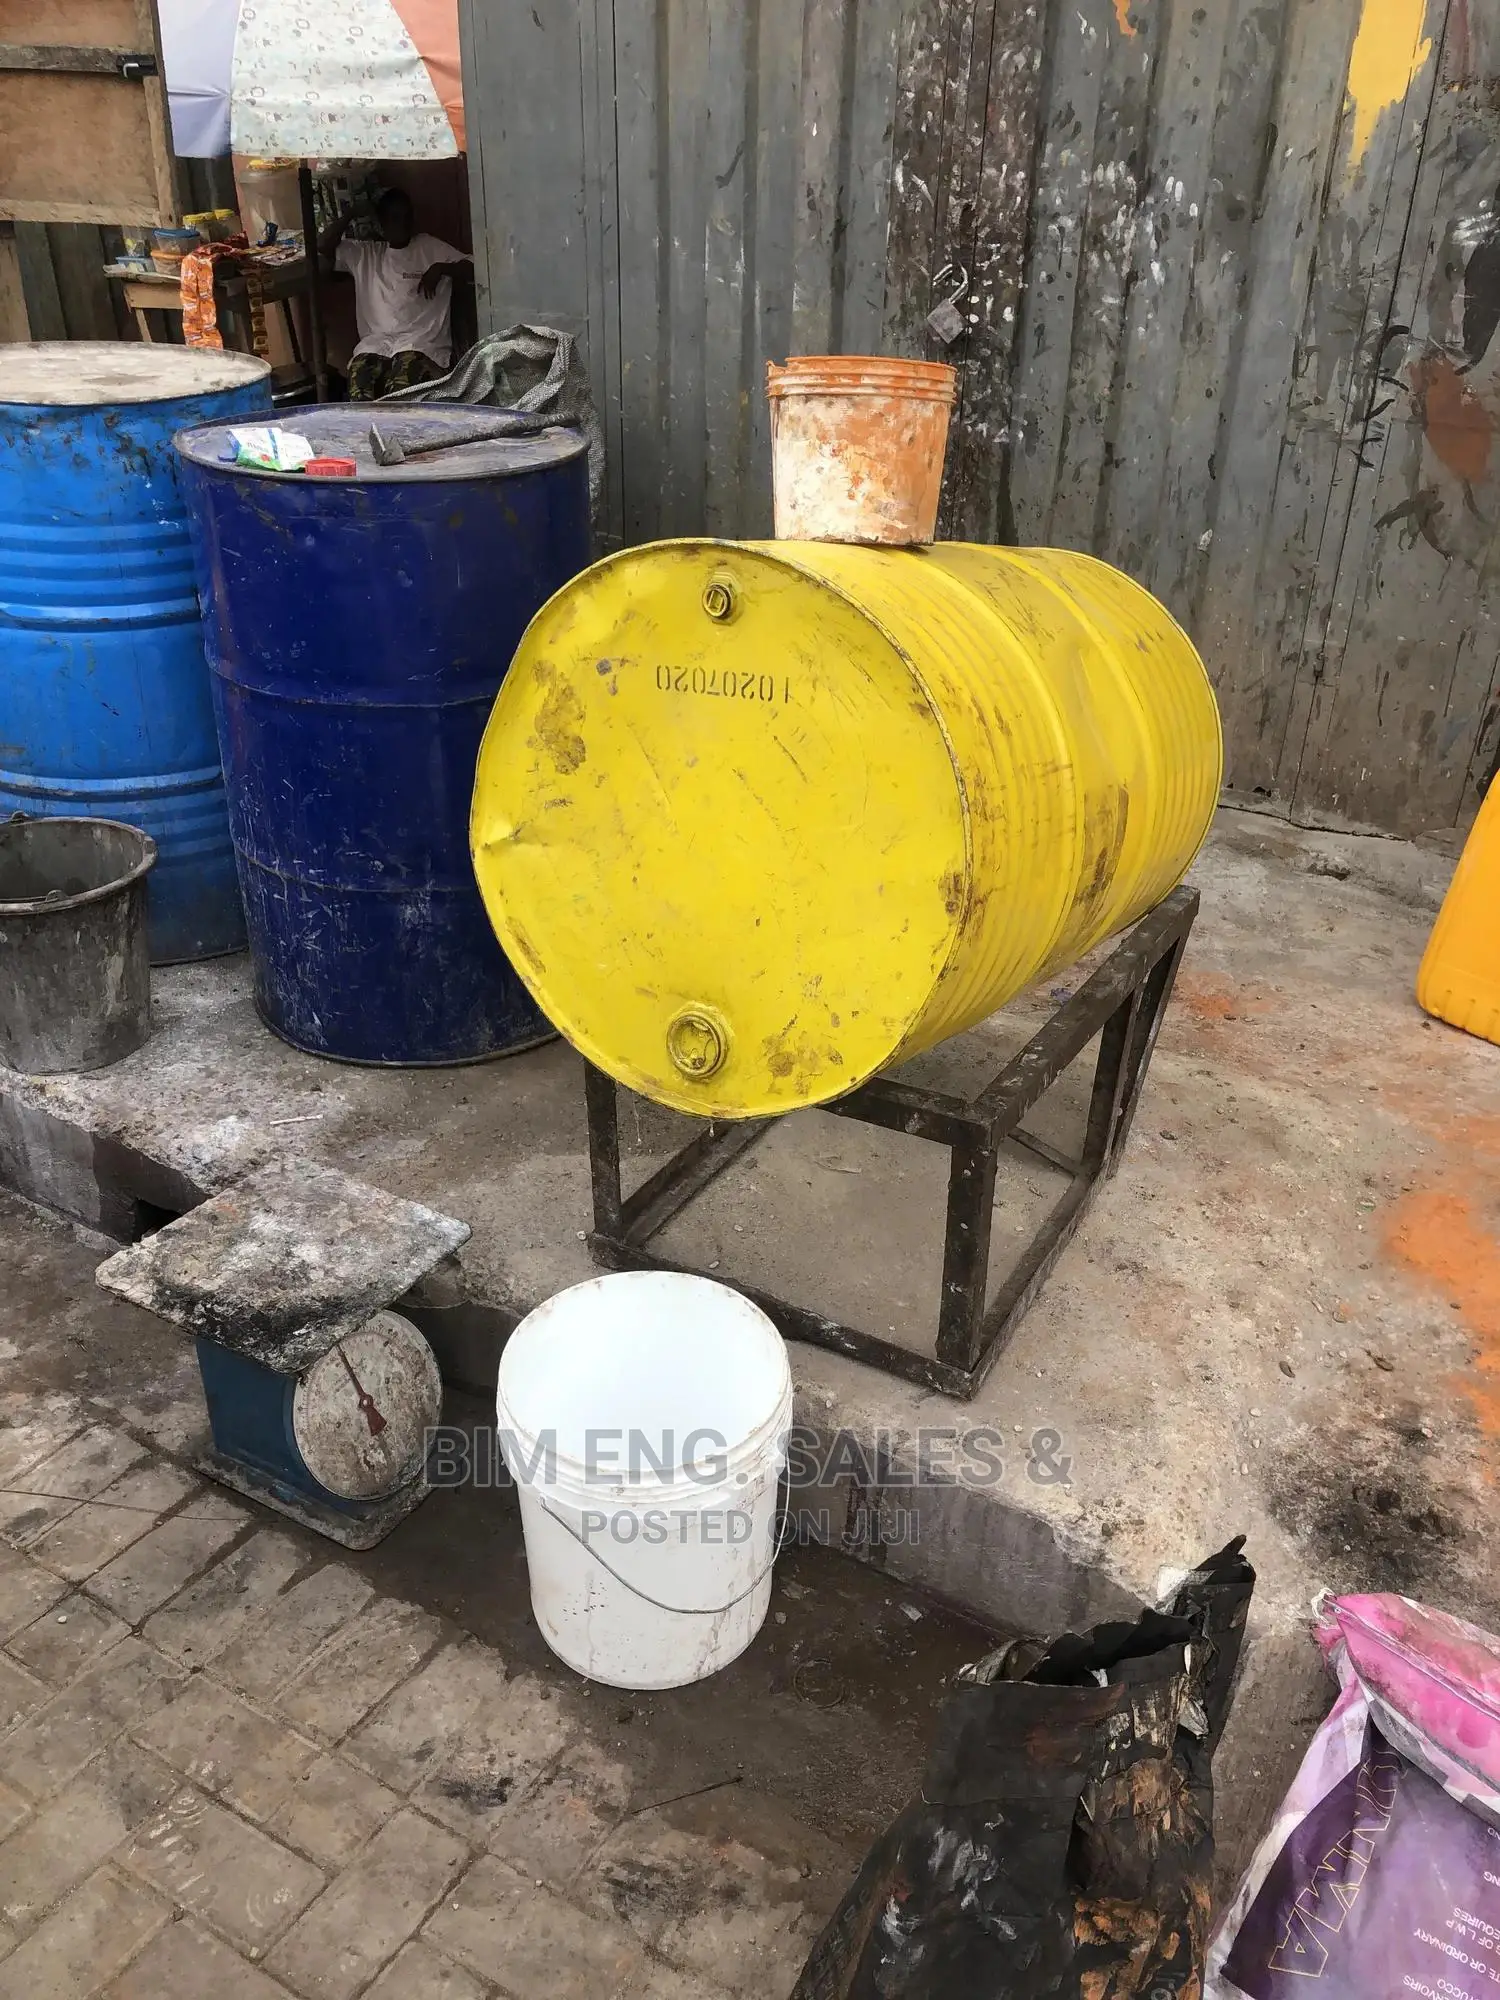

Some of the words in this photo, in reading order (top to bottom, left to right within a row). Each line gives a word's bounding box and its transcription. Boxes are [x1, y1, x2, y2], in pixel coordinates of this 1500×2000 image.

[656, 664, 790, 704] 10207020
[1413, 1927, 1469, 1964] ORDINARY
[1469, 1957, 1487, 1974] OR
